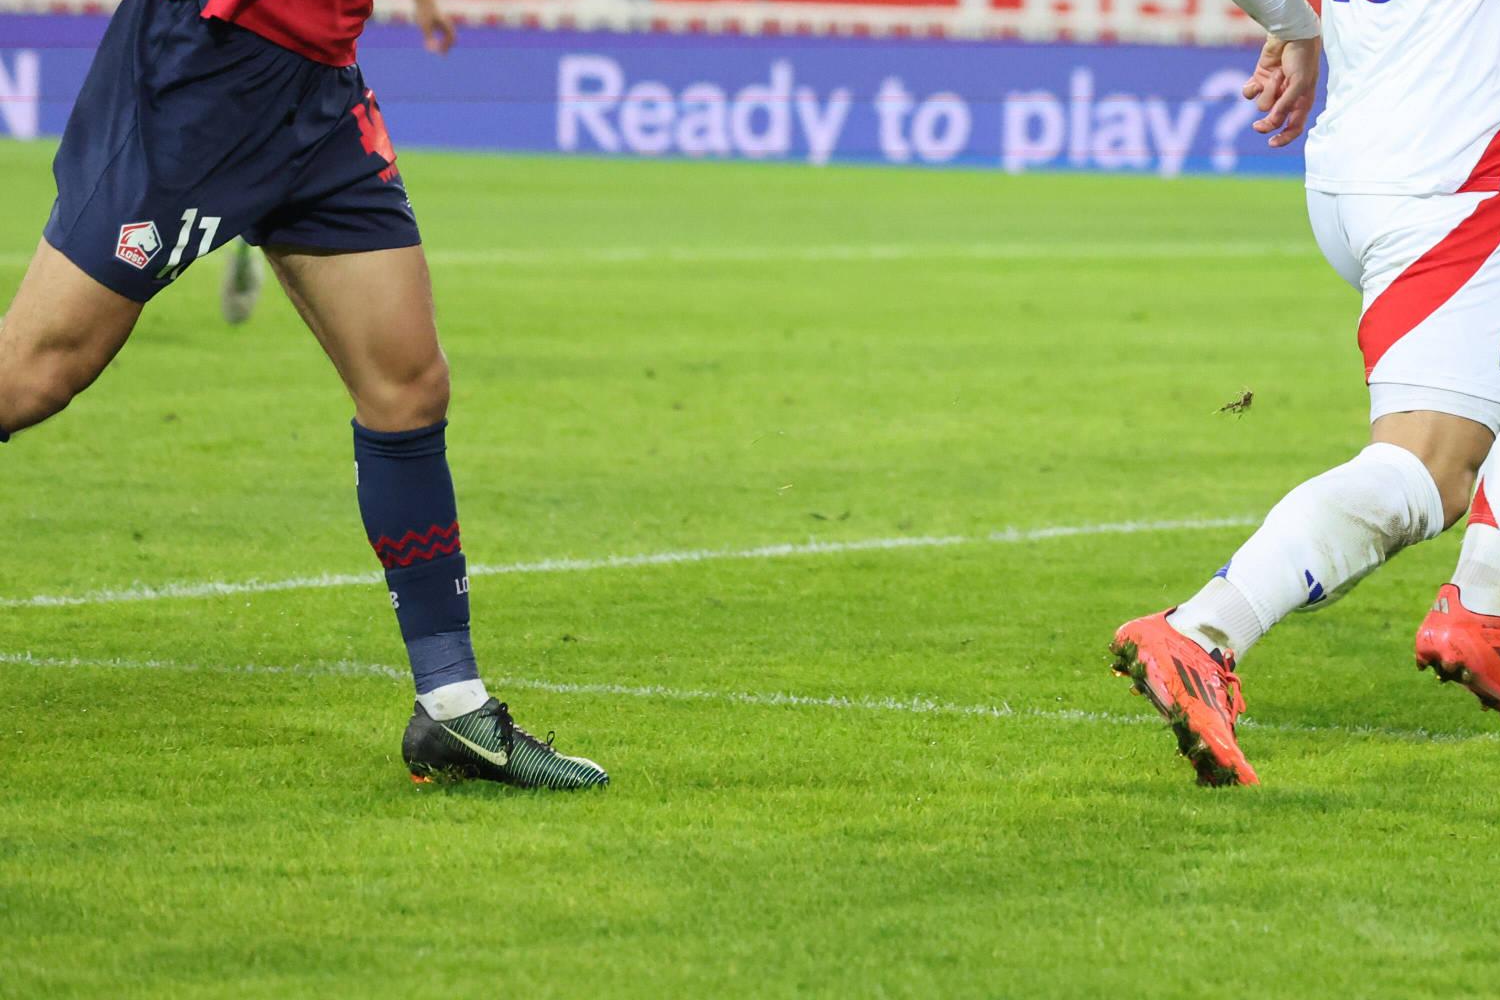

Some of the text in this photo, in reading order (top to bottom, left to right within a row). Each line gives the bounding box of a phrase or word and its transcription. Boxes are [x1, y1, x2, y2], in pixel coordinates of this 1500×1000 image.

[556, 54, 1255, 178] Ready to play?
[157, 208, 222, 280] 11
[454, 575, 469, 595] LO
